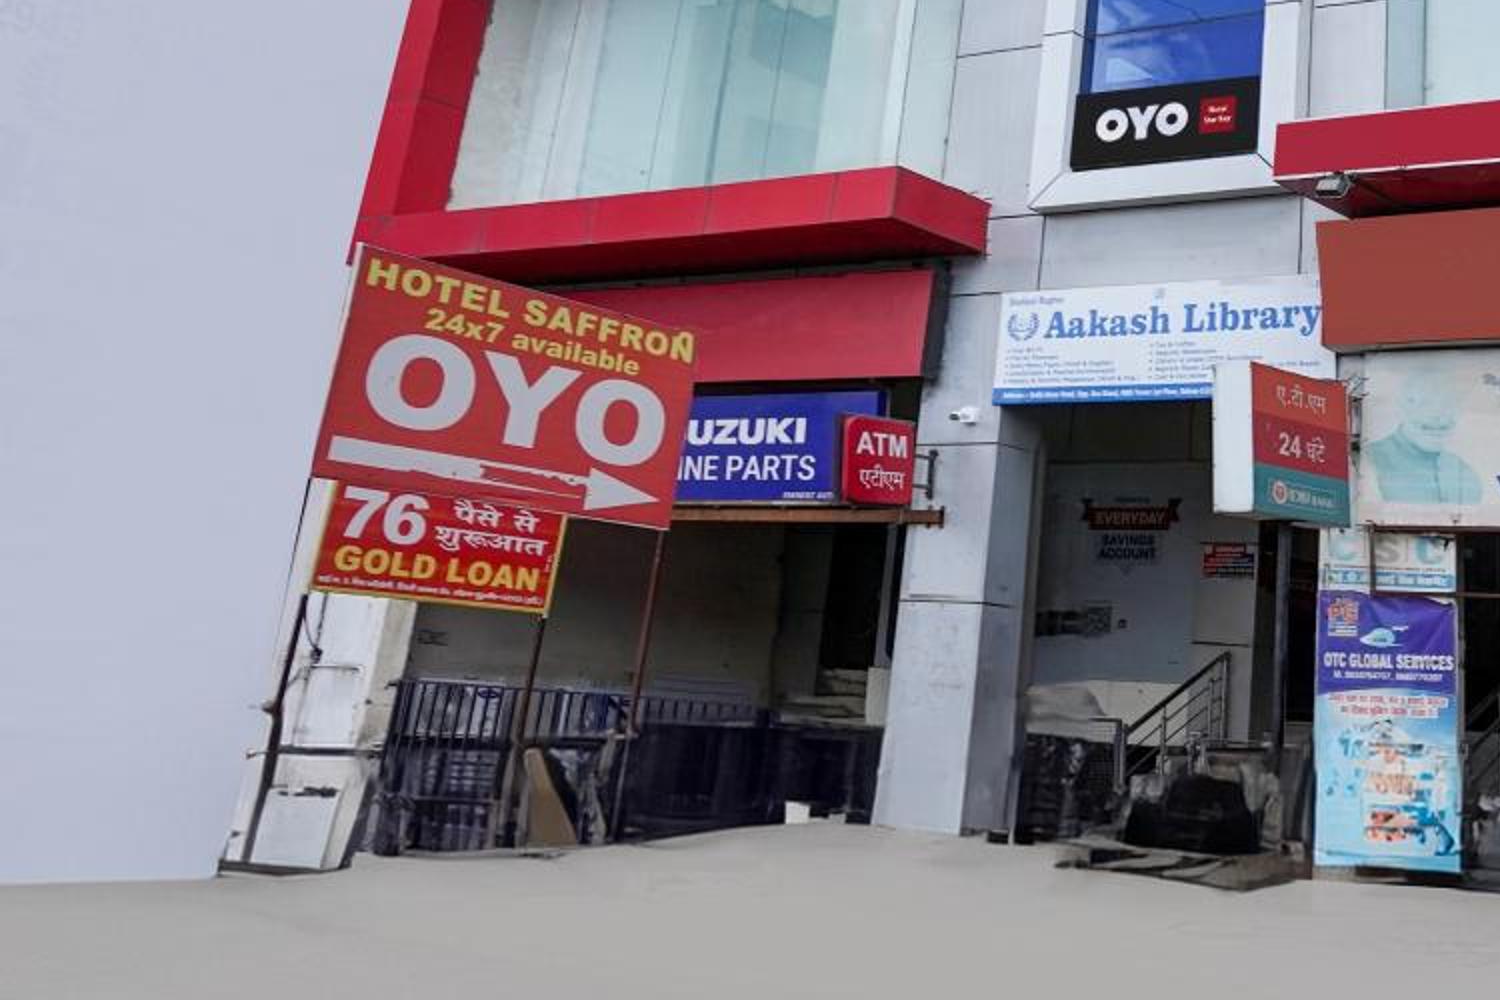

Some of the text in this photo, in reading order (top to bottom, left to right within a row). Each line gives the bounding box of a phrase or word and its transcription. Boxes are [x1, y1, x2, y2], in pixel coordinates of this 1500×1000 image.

[1096, 101, 1189, 142] OYO
[366, 258, 695, 364] HOTEL SAFFRON
[1044, 302, 1322, 339] Aakash Library
[425, 308, 641, 375] 24x7 available
[365, 334, 666, 466] OYO
[685, 417, 806, 445] UZUKI
[856, 431, 907, 458] ATM
[1279, 432, 1302, 459] 24
[725, 455, 816, 481] PARTS
[858, 464, 906, 490] एटीएम
[343, 485, 431, 545] 76
[512, 508, 541, 533] से
[1096, 509, 1166, 525] EVERYDAY
[1097, 547, 1156, 560] ACCOUNT
[1103, 534, 1154, 546] SAVINGS
[334, 545, 437, 579] GOLD
[445, 558, 540, 592] LOAN
[1323, 653, 1455, 672] OTC GLOBAL SERVICES
